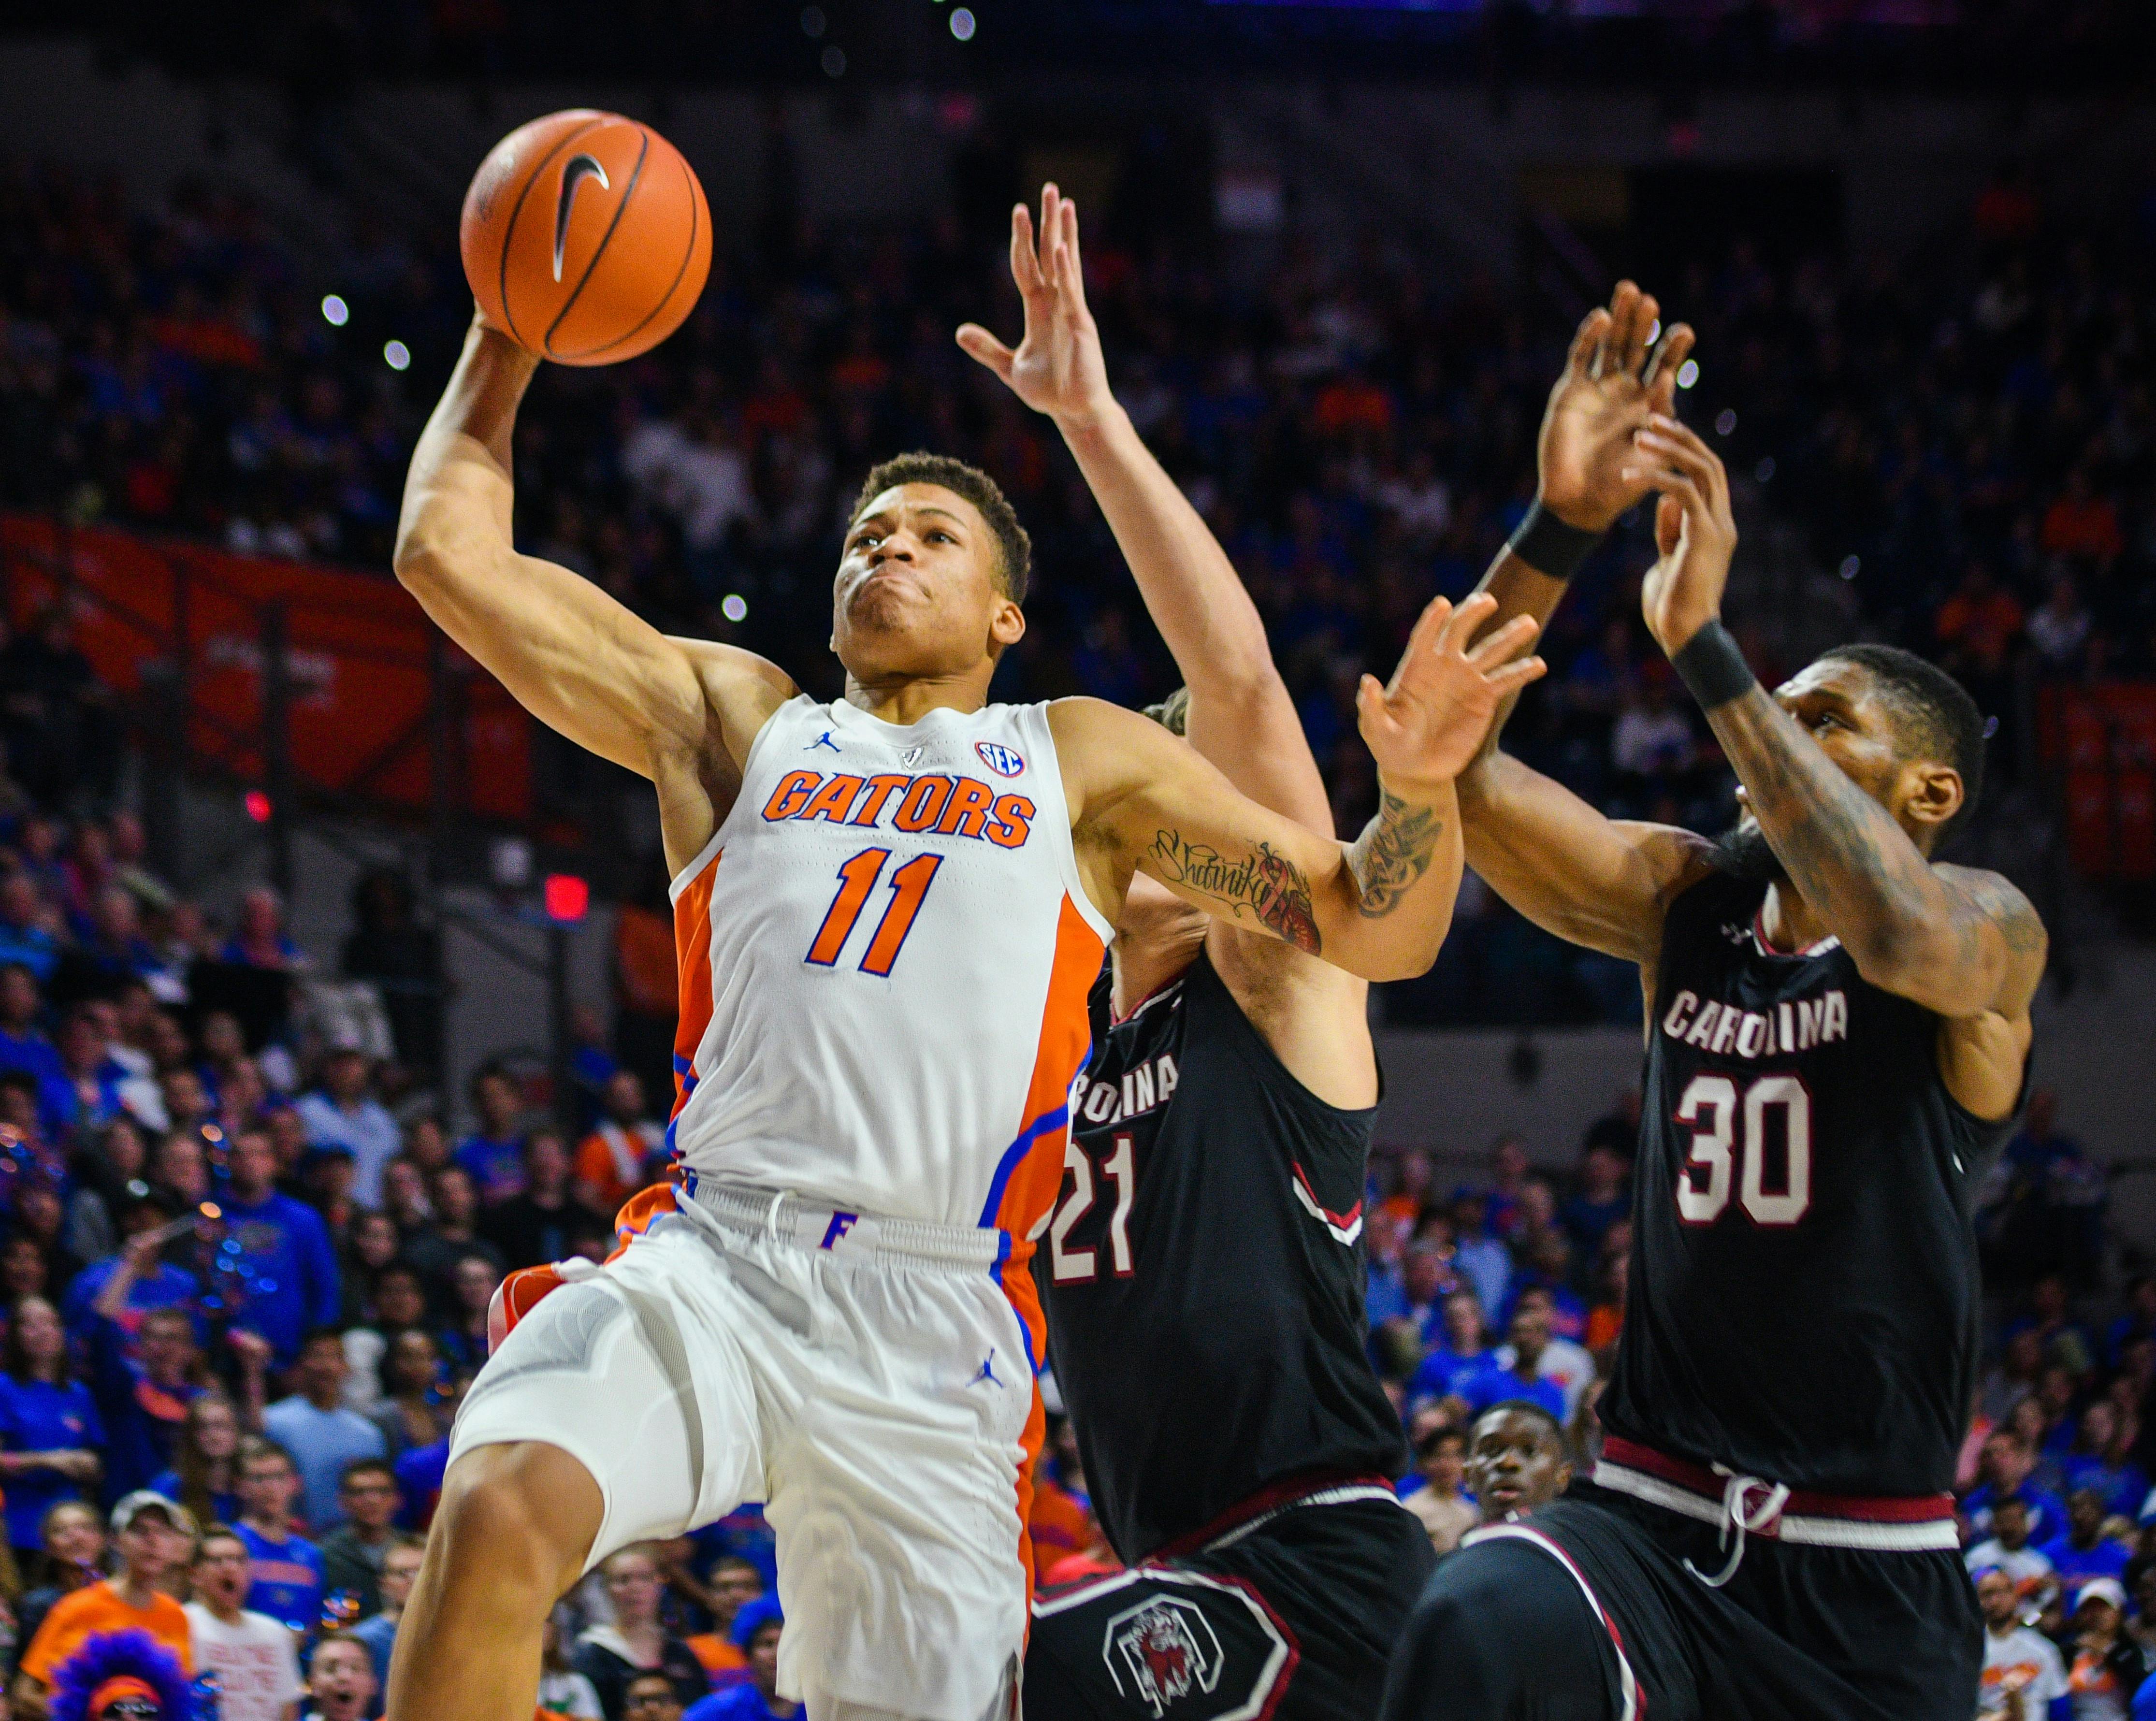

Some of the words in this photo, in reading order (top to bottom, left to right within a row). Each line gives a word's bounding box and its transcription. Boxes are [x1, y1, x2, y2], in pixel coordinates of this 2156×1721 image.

[977, 743, 1021, 775] SEC
[761, 770, 1036, 849] GATORS
[804, 847, 944, 978] 11
[1068, 1053, 1179, 1125] ROINA
[1674, 1071, 1814, 1228] 30
[818, 1209, 859, 1251] F
[1049, 1132, 1135, 1287] 21
